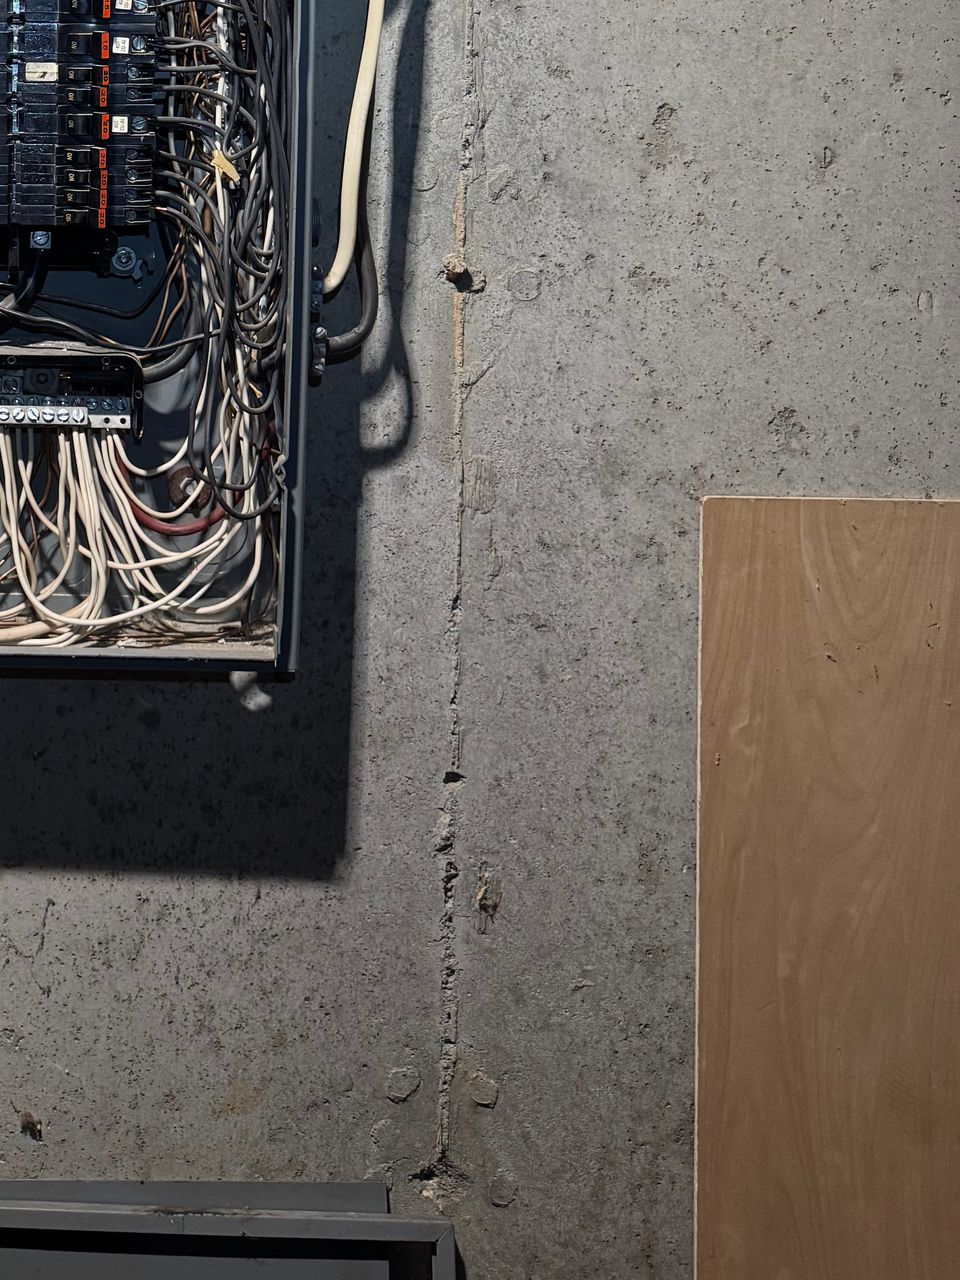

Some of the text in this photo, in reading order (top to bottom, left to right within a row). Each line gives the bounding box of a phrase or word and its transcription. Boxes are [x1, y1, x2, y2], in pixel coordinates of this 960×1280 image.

[104, 70, 109, 81] 20
[101, 89, 106, 103] 20
[103, 120, 109, 133] 20
[100, 153, 106, 164] 20
[102, 174, 106, 185] 20
[101, 194, 106, 205] 20
[100, 213, 104, 225] 20
